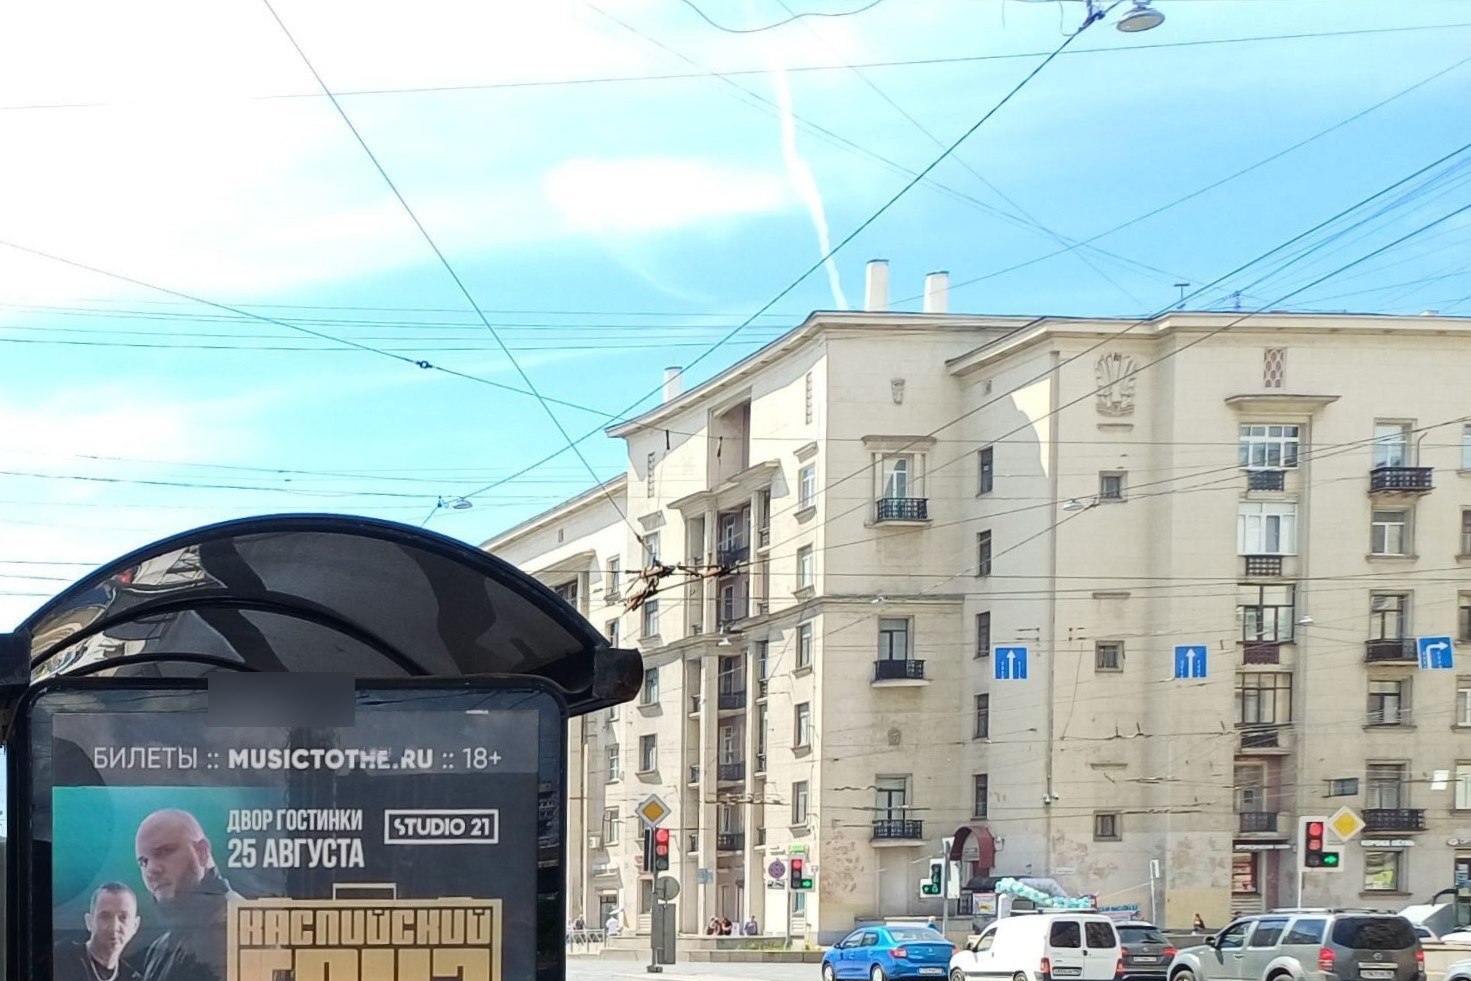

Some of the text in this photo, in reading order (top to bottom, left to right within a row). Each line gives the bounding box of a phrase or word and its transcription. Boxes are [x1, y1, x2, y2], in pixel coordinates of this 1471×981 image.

[93, 747, 198, 770] БИЛЕТЫ
[228, 748, 433, 770] MUSICTOTHE.RU
[463, 748, 502, 769] 18+
[227, 809, 363, 833] ДВОР ГОСТИНКИ
[393, 817, 490, 837] STUDIO 21
[227, 837, 365, 868] 25 АВГУСТА
[238, 908, 492, 946] КАСПИЙСКИЙ
